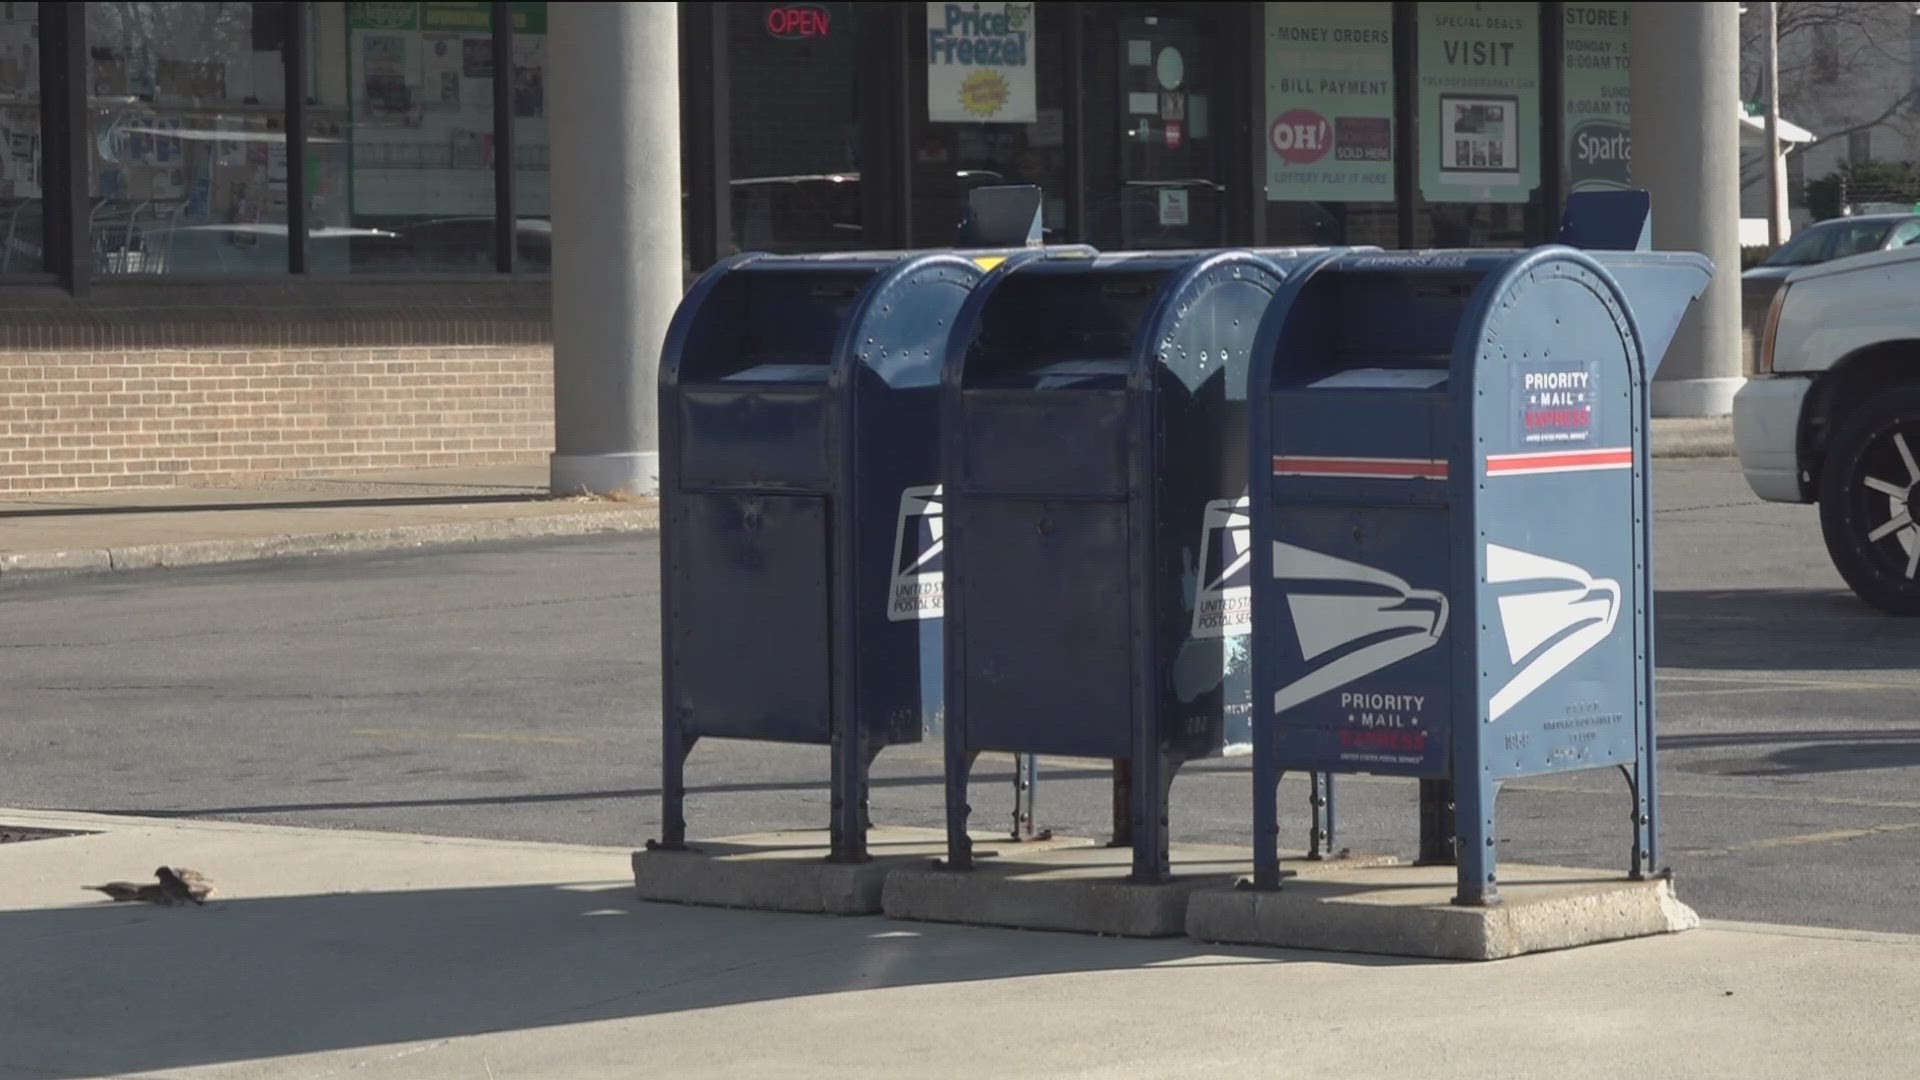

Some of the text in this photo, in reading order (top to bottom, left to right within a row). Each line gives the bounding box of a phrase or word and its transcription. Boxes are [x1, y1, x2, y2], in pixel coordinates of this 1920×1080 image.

[768, 8, 828, 36] OPEN
[1433, 15, 1522, 30] SPECIAL DEALS
[1566, 7, 1618, 26] STORE
[1279, 27, 1389, 43] MONEY ORDERS
[1443, 40, 1514, 66] VISIT
[1566, 40, 1611, 52] MONDAY
[1567, 53, 1630, 70] 8:00AM TO
[1281, 78, 1388, 95] BILL PAYMENT
[1614, 101, 1630, 115] TO
[1273, 120, 1326, 151] OH!
[1337, 147, 1389, 159] SOLD HERE
[1274, 172, 1319, 184] LOTTERY
[1525, 372, 1589, 390] PRIORITY
[1541, 391, 1574, 407] MAIL
[896, 583, 932, 597] UNITED
[894, 597, 929, 612] POSTAL
[1200, 598, 1236, 613] UNITED
[1199, 613, 1232, 629] POSTAL
[1341, 692, 1425, 711] PRIORITY
[1361, 712, 1405, 728] MAIL
